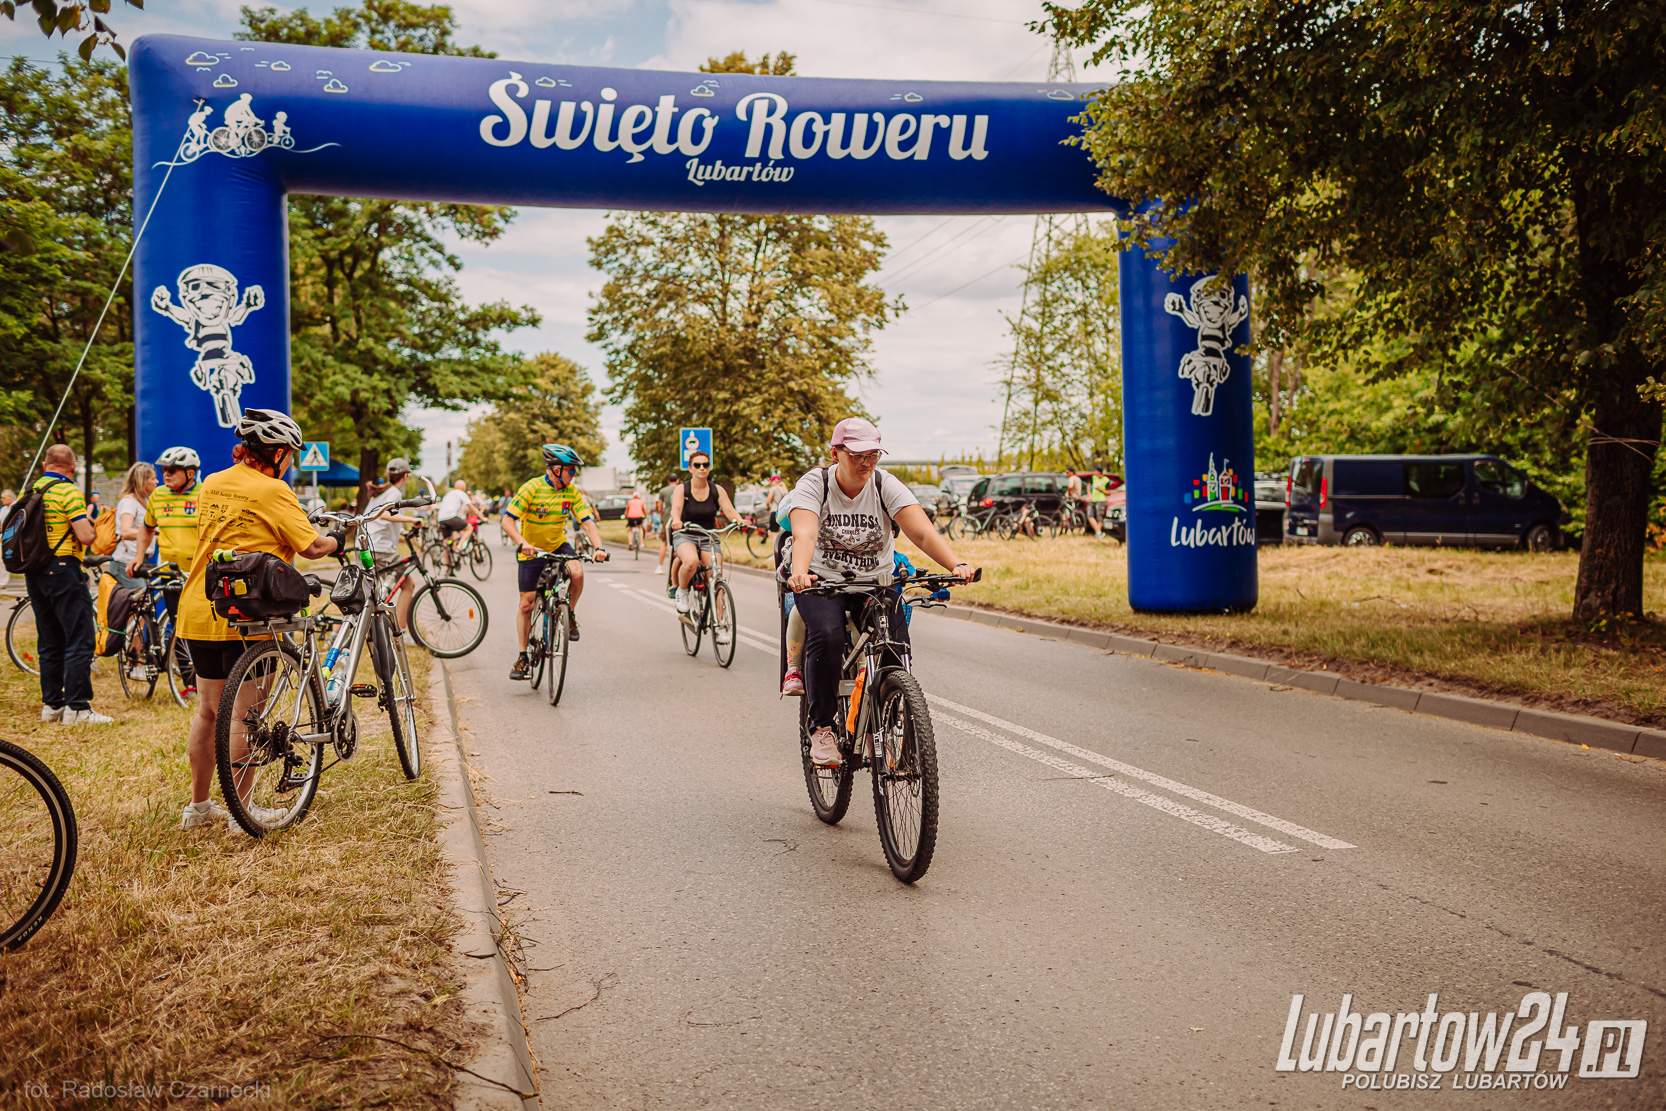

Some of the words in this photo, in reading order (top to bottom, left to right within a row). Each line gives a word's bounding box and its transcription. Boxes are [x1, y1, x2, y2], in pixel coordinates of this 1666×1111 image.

[479, 71, 719, 164] Święto
[735, 92, 990, 161] Roweru
[685, 158, 794, 187] Lubartów
[1170, 516, 1255, 548] Lubartów
